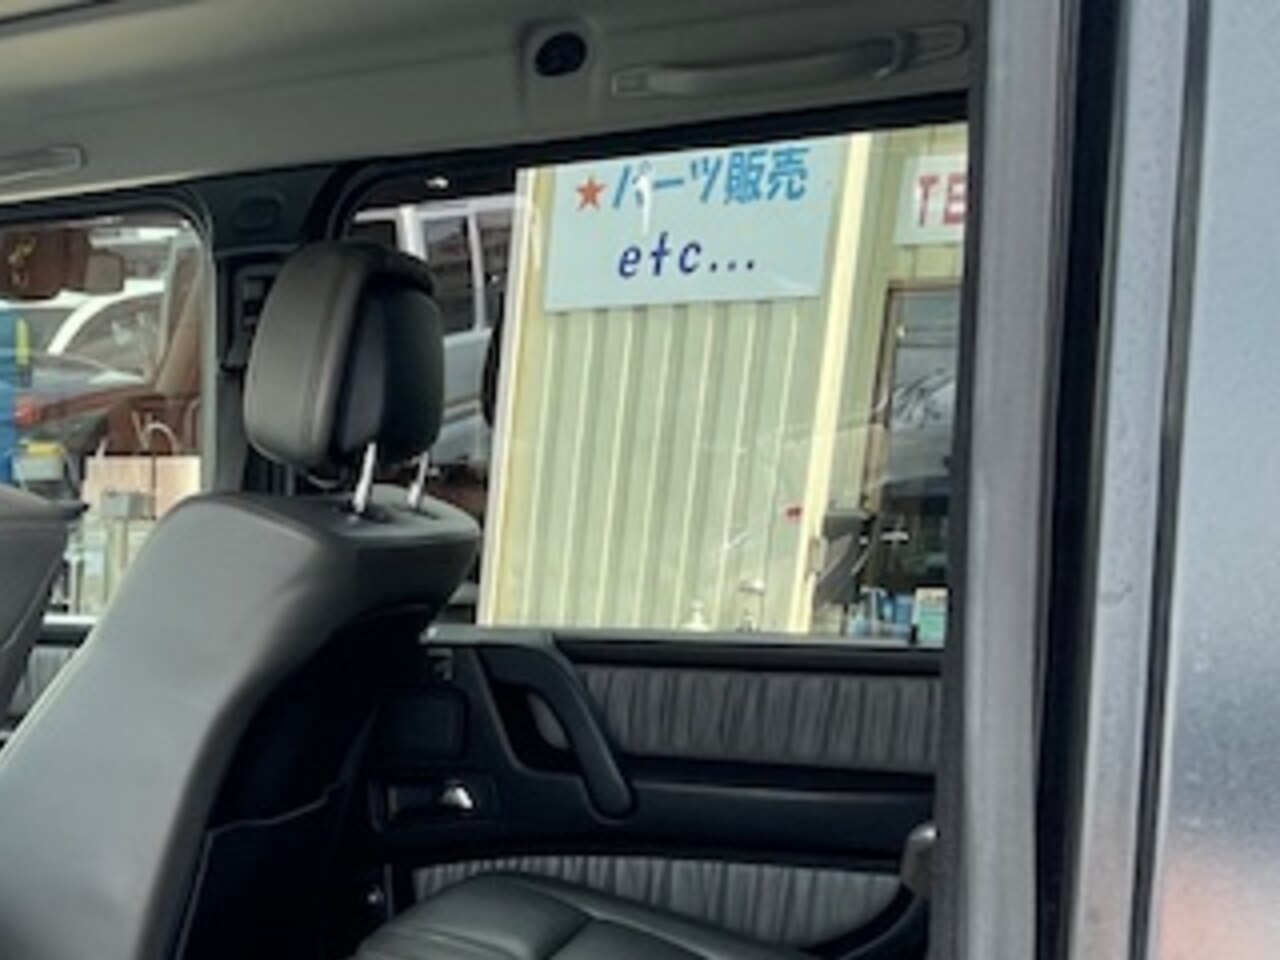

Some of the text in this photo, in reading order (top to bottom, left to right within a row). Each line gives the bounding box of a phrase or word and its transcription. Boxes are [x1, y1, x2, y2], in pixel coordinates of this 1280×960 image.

[612, 147, 809, 208] パーツ販売
[619, 231, 755, 277] etc...
